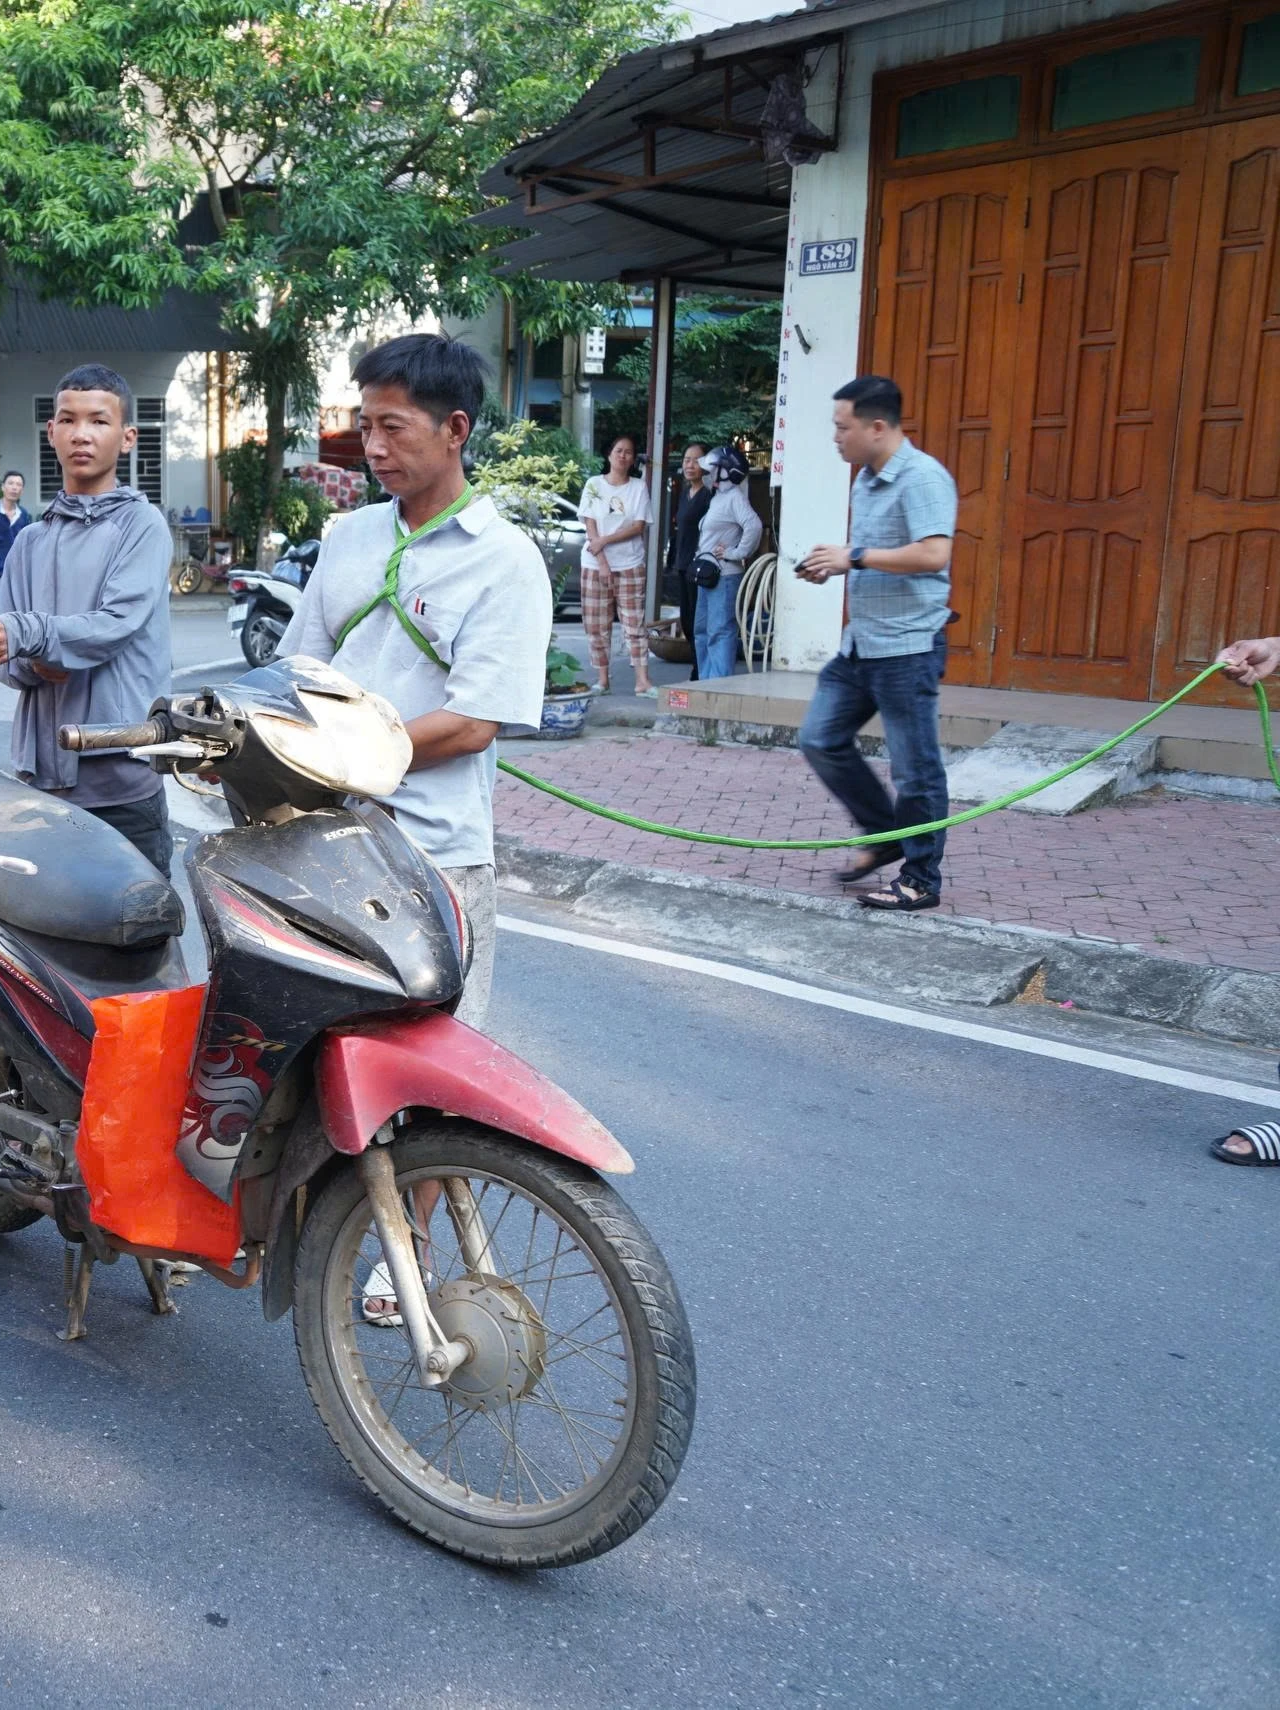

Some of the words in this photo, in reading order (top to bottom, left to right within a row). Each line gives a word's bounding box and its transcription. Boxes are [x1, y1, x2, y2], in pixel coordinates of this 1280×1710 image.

[806, 243, 851, 263] 189
[806, 262, 821, 272] NGÔ
[322, 826, 373, 841] HONDA
[25, 980, 54, 1003] EDITION
